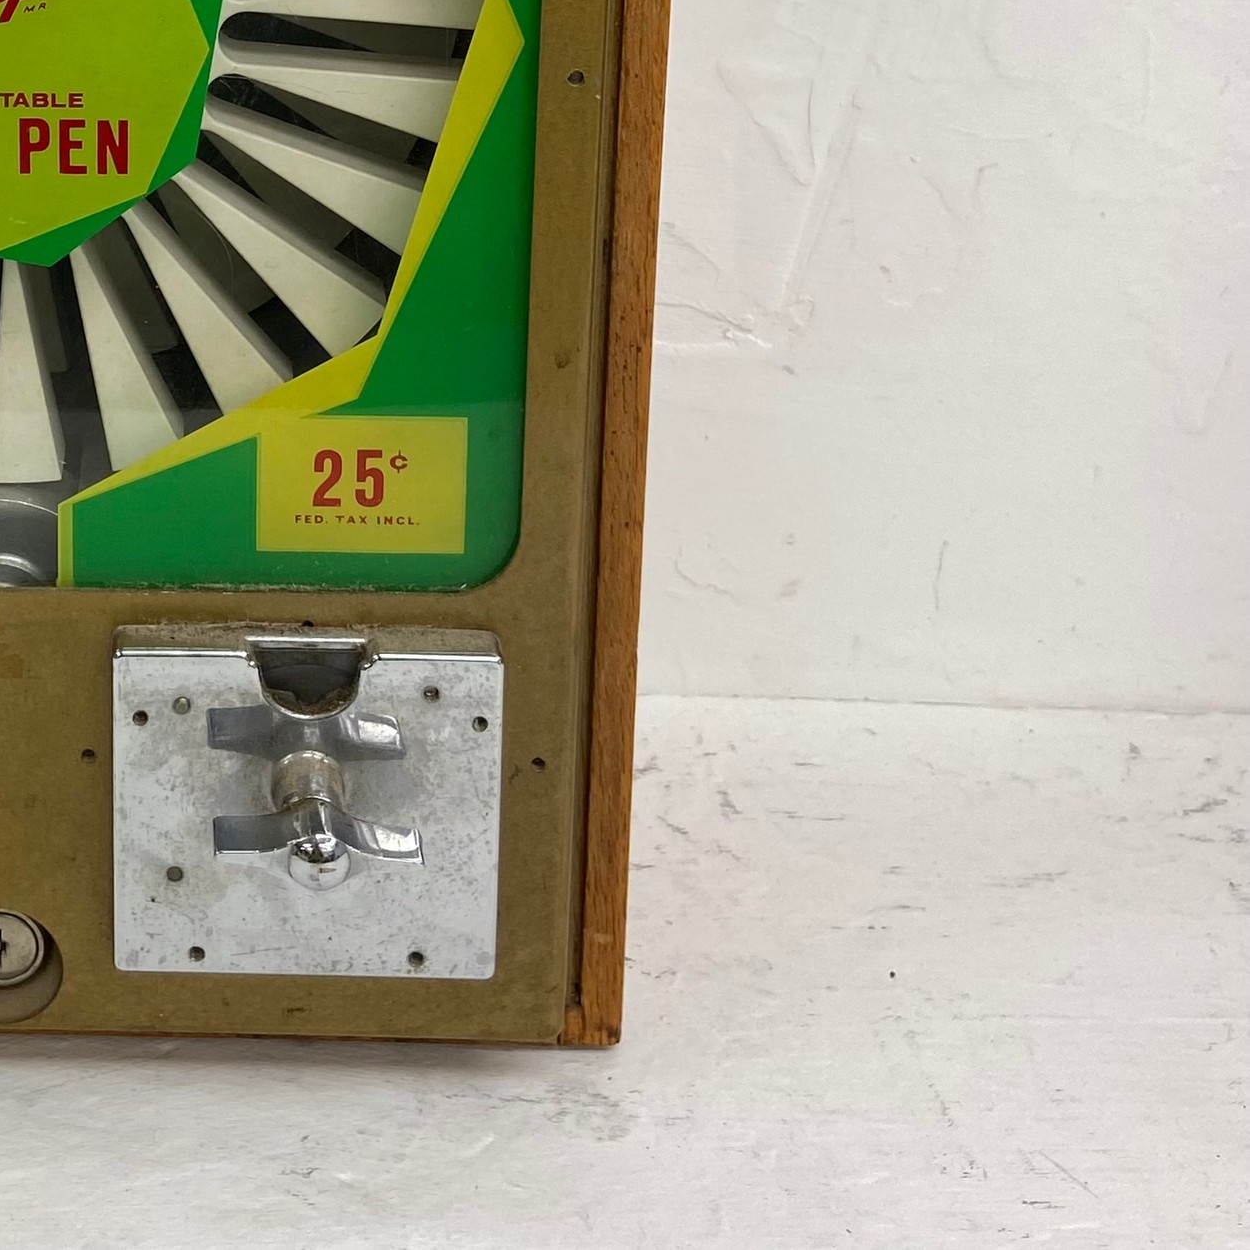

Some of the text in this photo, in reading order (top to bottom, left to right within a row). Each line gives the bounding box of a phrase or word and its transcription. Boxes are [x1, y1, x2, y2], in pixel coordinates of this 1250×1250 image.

[19, 118, 129, 175] PEN
[295, 514, 420, 525] FED. TAX INCL.
